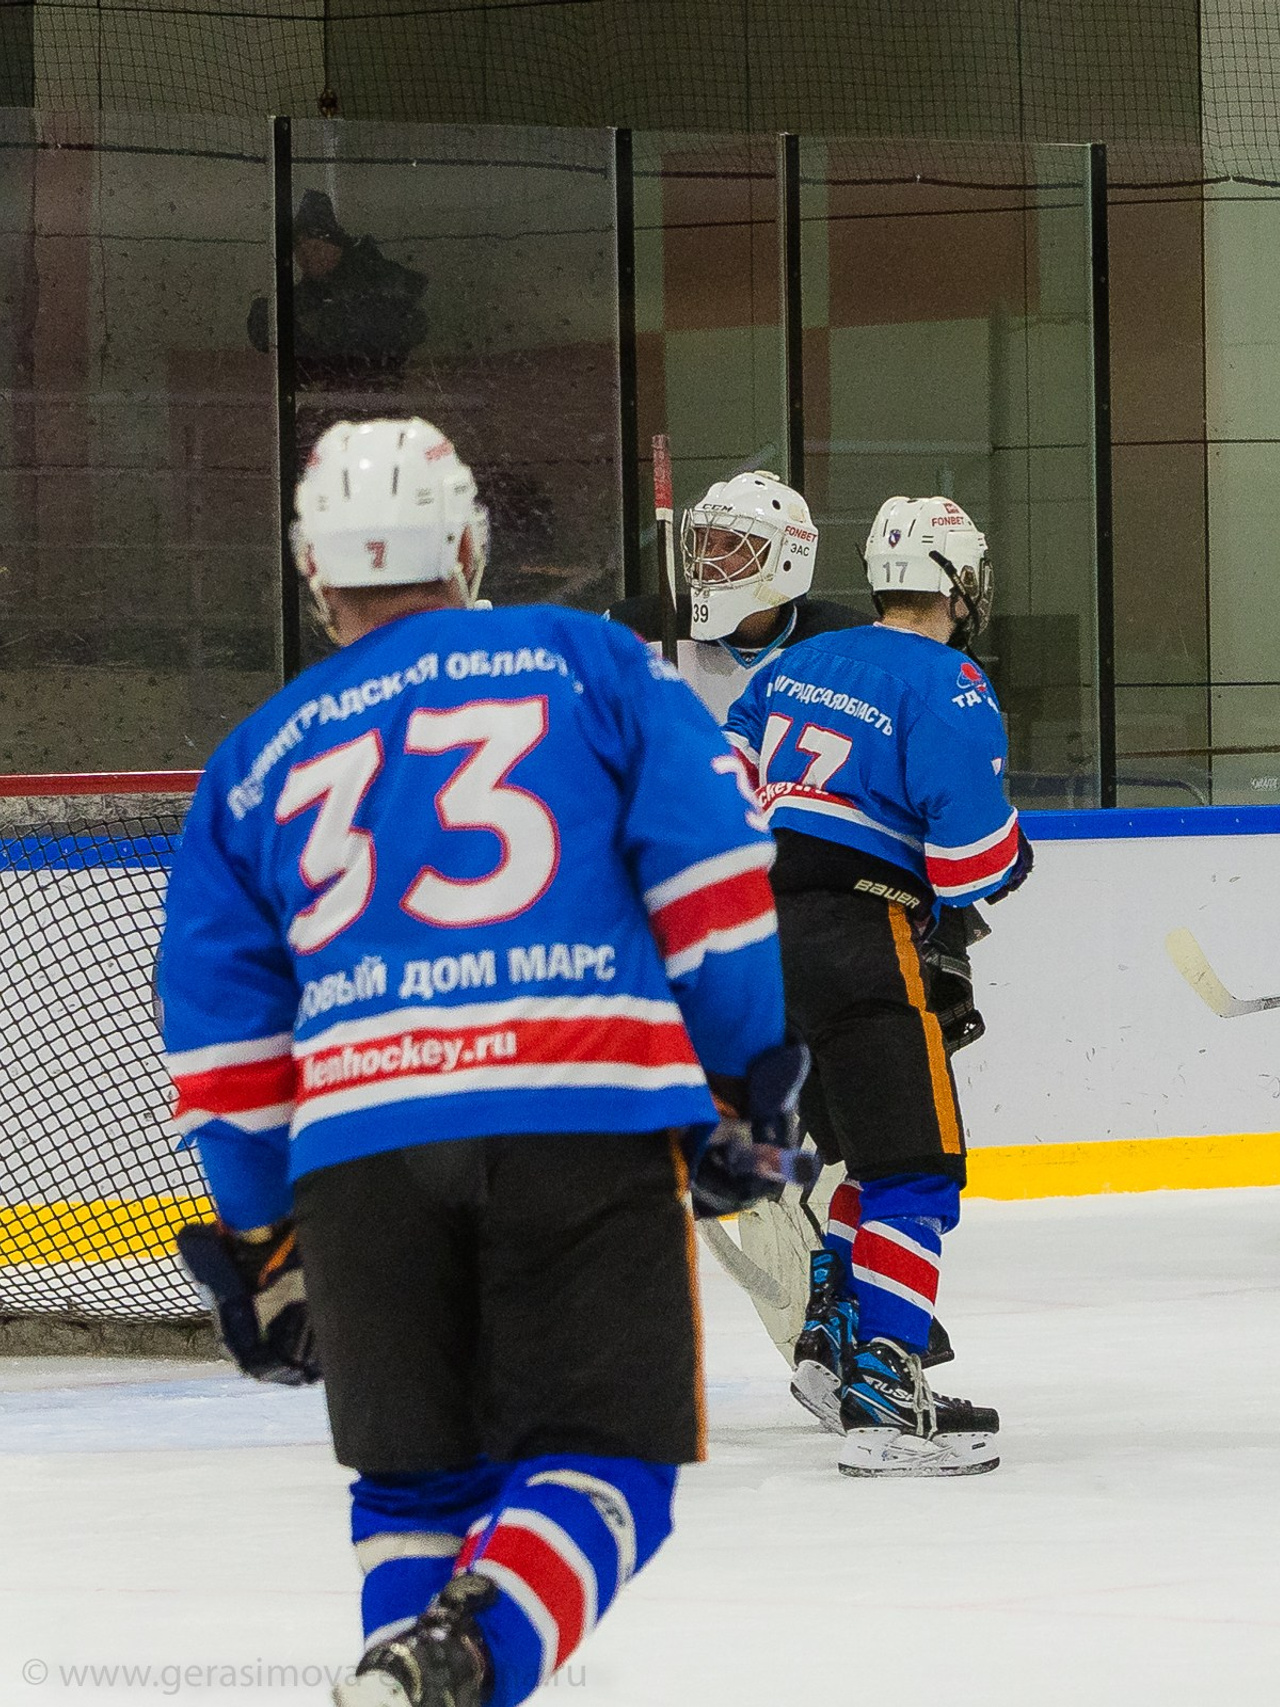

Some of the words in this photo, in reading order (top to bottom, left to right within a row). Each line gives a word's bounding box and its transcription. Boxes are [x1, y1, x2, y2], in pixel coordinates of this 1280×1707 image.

[702, 503, 733, 513] CCM
[931, 516, 964, 527] FONBET
[785, 525, 818, 543] FONBET
[882, 561, 908, 583] 17
[693, 603, 709, 623] 39
[275, 694, 560, 955] 33
[853, 879, 920, 909] BAUER
[399, 950, 496, 1000] ДОМ
[508, 944, 616, 985] МАРС
[303, 1030, 517, 1090] lenhockey.ru
